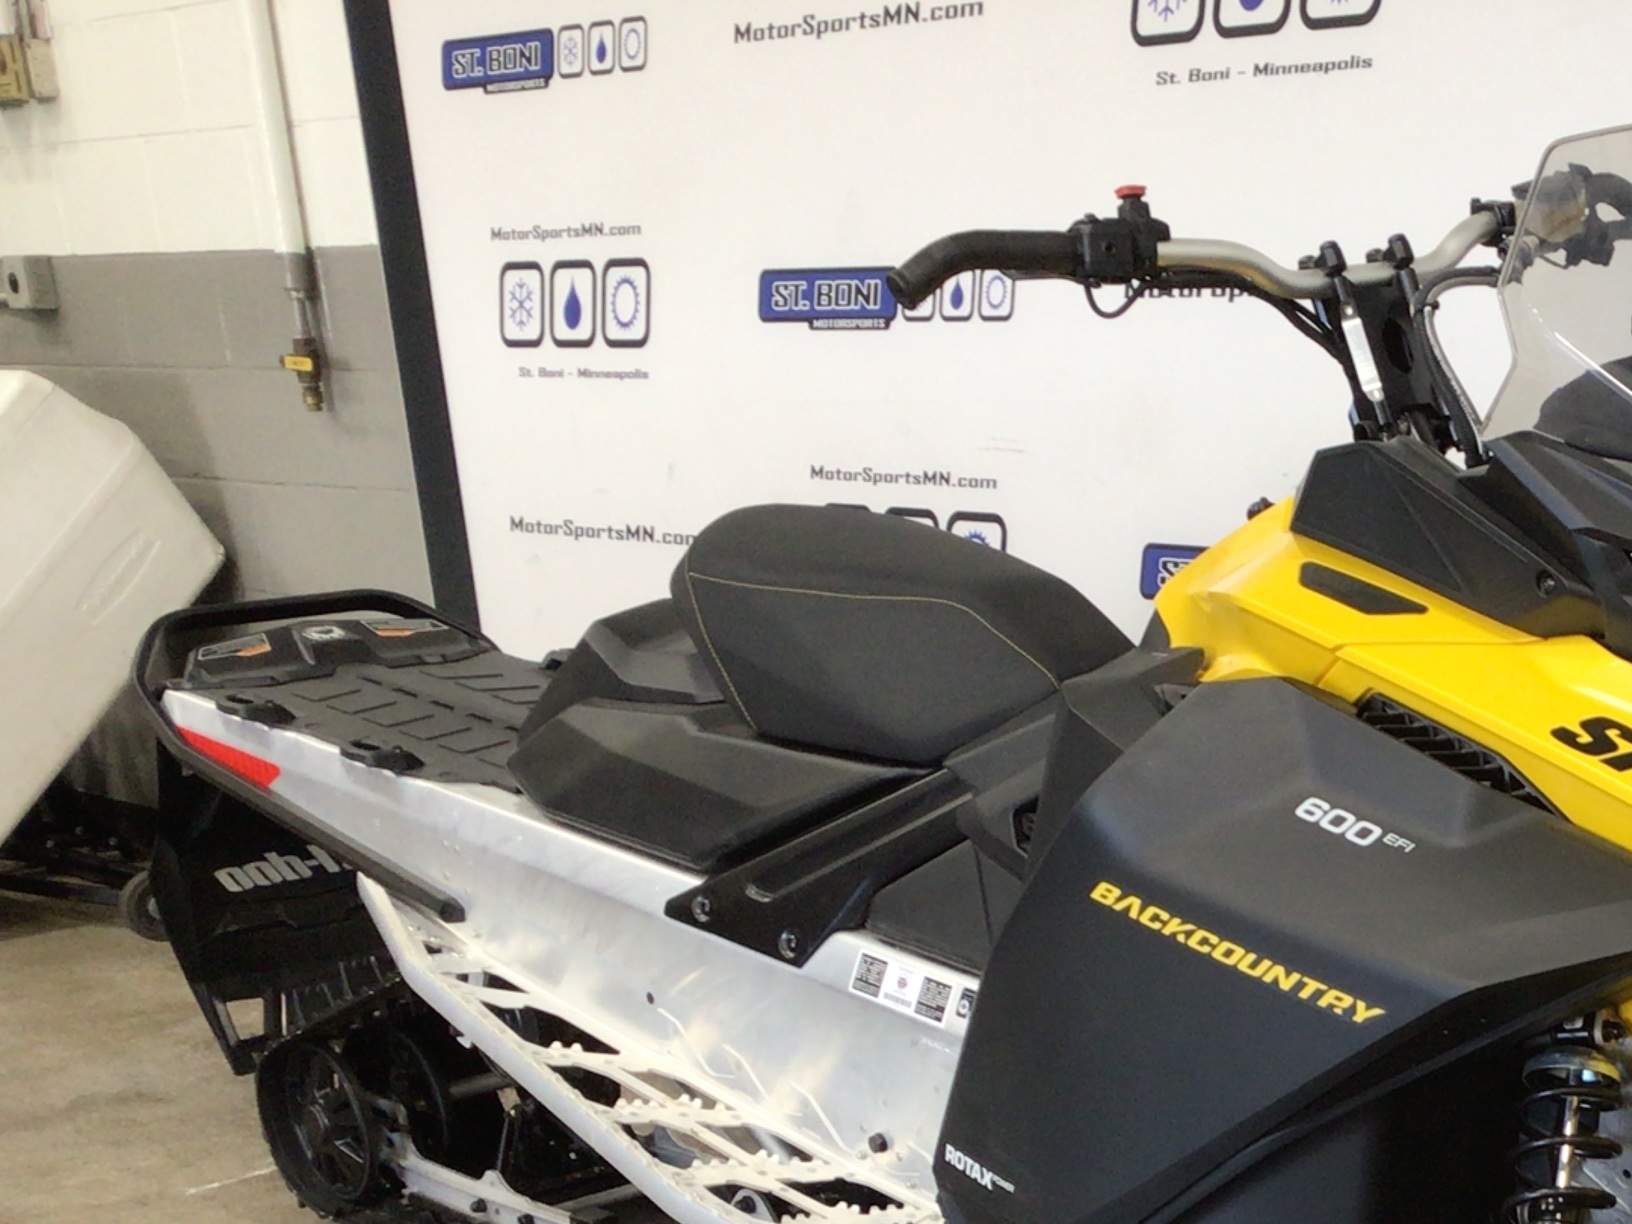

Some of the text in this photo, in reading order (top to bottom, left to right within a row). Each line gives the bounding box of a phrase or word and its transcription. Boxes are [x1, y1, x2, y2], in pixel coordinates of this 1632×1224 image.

[733, 1, 984, 43] MotorSportsMN.com
[452, 41, 540, 78] ST. BONI
[1155, 70, 1181, 85] St.
[1189, 66, 1230, 84] Boni
[1253, 55, 1373, 78] Minneapolis
[490, 221, 641, 242] MotorSportsMN.com
[771, 279, 881, 310] ST. BONI
[810, 465, 998, 490] MotorSportsMN.com
[1294, 797, 1416, 853] 600 EFI
[1089, 880, 1386, 1024] BACKCOUNTRY
[944, 1143, 993, 1191] ROTAX
